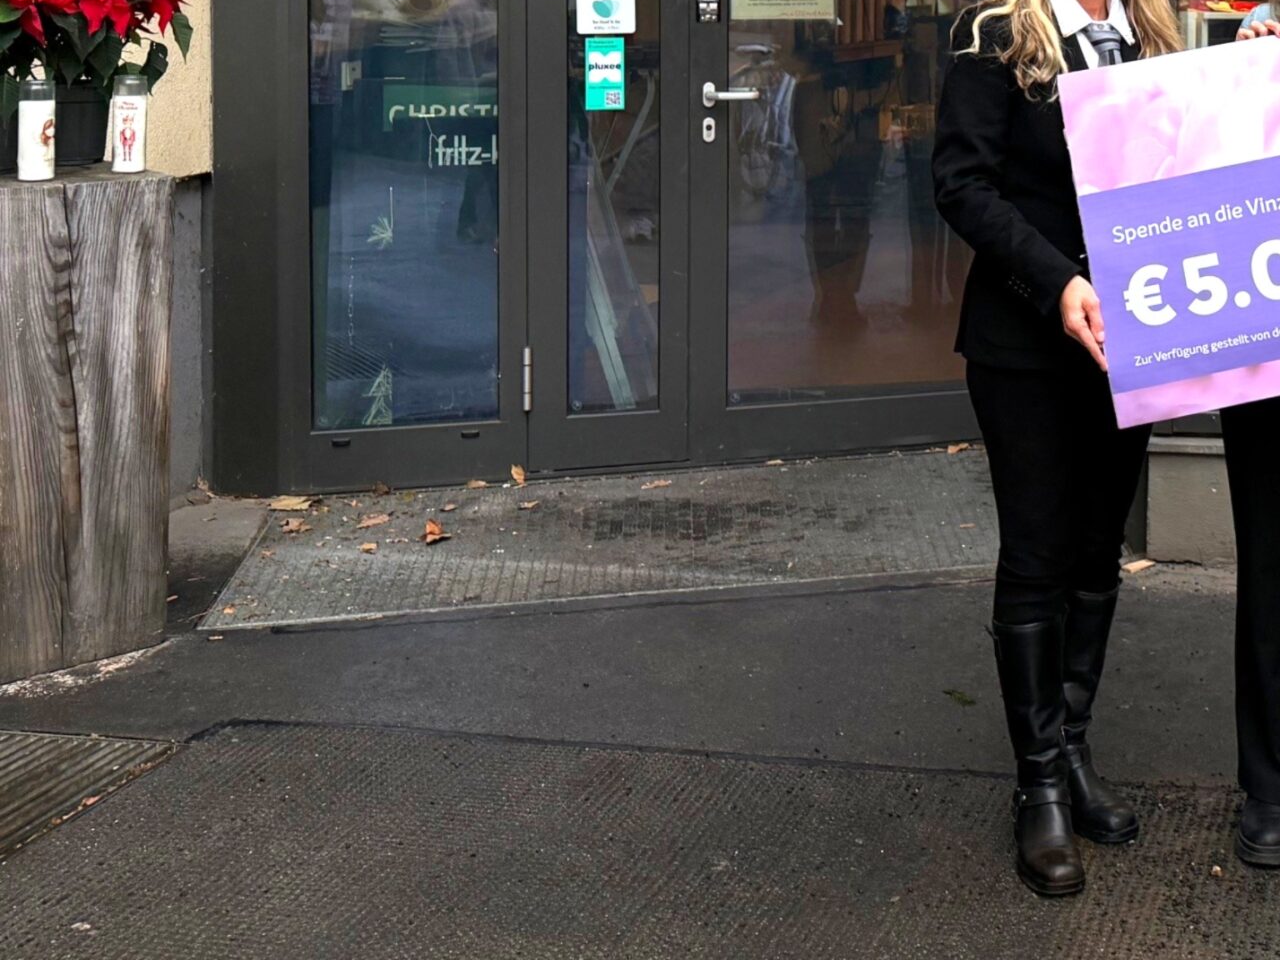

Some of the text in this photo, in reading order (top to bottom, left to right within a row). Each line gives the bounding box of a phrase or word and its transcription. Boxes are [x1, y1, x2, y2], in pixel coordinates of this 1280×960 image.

[588, 61, 622, 72] pluxee
[1112, 216, 1184, 245] Spende
[1187, 212, 1211, 229] an
[1214, 203, 1243, 223] die
[1134, 355, 1152, 367] Zur
[1153, 342, 1210, 362] Verfügung
[1210, 334, 1250, 353] gestellt
[1250, 331, 1271, 343] von
